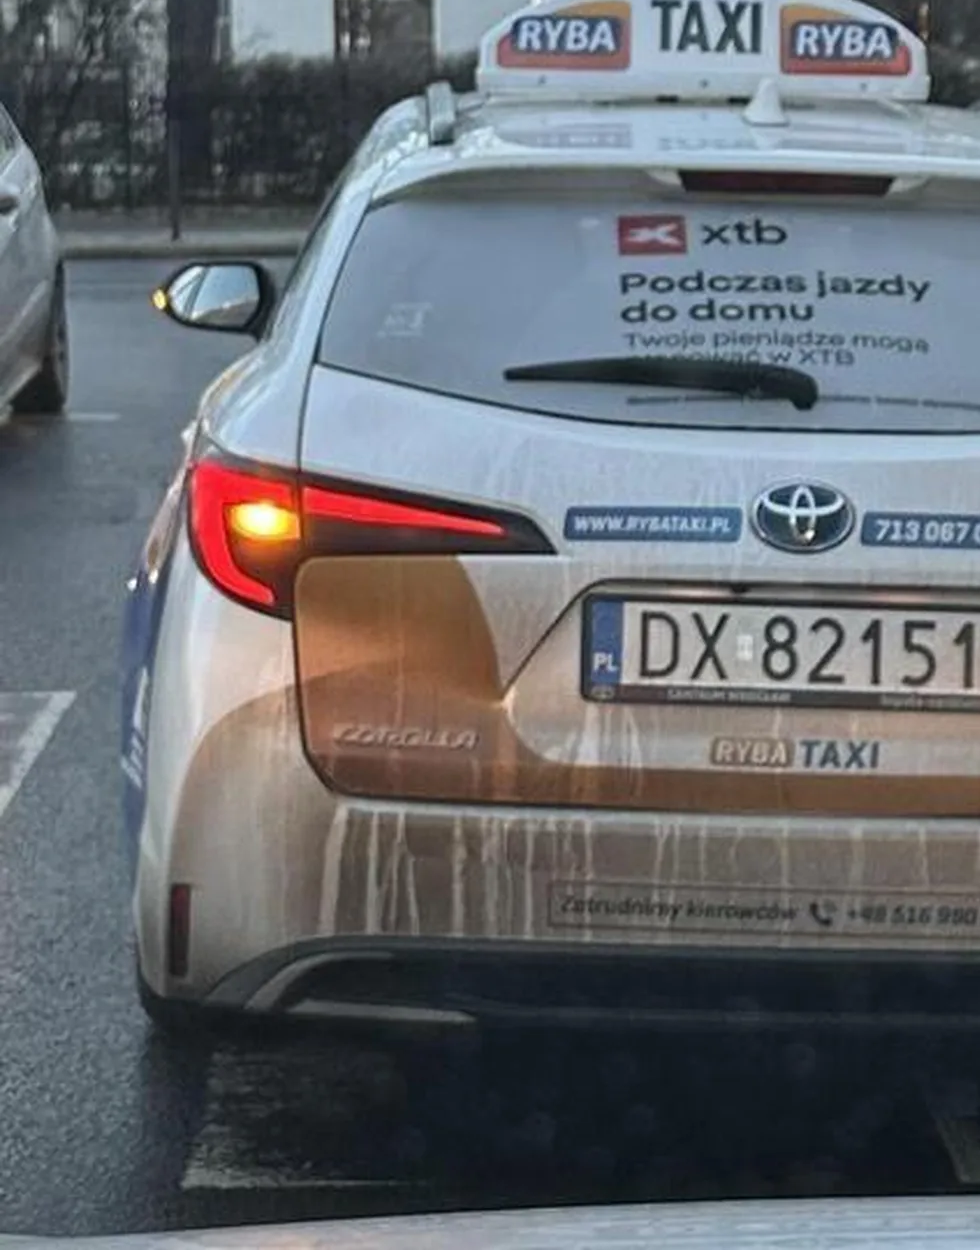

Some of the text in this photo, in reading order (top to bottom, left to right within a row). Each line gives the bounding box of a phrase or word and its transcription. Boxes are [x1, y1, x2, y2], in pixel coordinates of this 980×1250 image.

[515, 17, 616, 52] RYBA
[795, 24, 892, 59] RYBA
[702, 219, 788, 246] xtb
[620, 270, 931, 303] Podczas jazdy
[620, 298, 815, 323] do domu
[623, 330, 706, 349] Twoje
[713, 328, 846, 348] pieniądze
[766, 351, 792, 364] w
[799, 349, 855, 366] XTB
[875, 518, 920, 542] 713
[924, 520, 970, 544] 067
[592, 652, 618, 674] PL
[638, 610, 977, 690] DX 82151
[715, 739, 881, 769] RYBA TAXI
